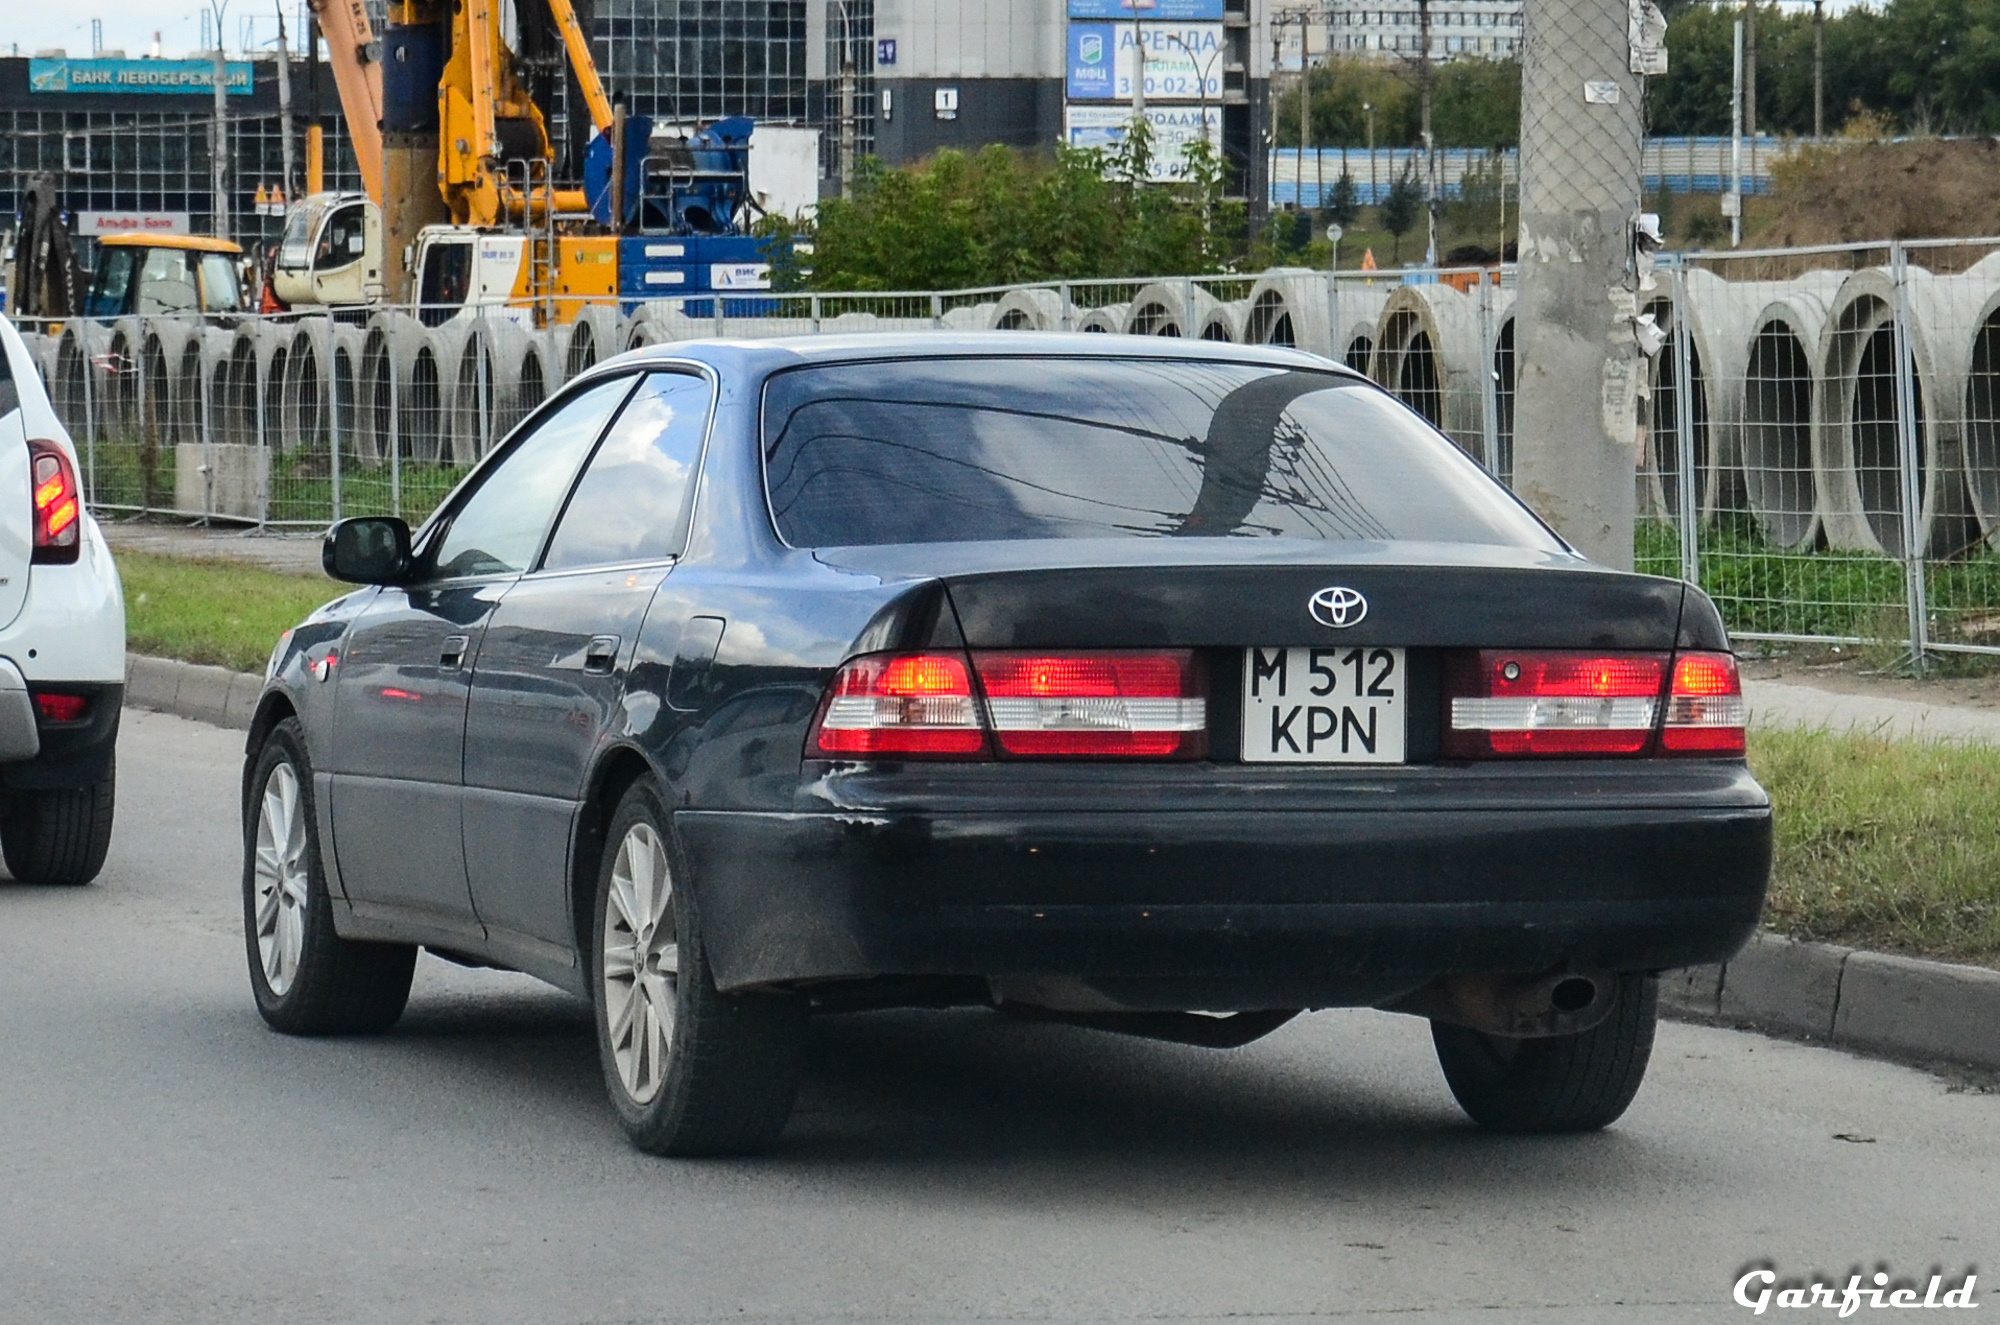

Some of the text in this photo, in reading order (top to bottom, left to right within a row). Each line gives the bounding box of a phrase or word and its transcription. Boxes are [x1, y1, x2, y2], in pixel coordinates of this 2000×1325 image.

[1120, 30, 1218, 55] АРЕНДА
[1075, 67, 1107, 81] МФЦ
[1138, 60, 1198, 73] ЕКЛАМА
[71, 70, 247, 87] БАНК ЛЕВОБЕРЕЖЫЙ
[1119, 77, 1218, 94] 30-02-20
[1141, 112, 1217, 126] РОДАЖА
[1251, 648, 1395, 697] M 512
[1271, 705, 1377, 754] KPN
